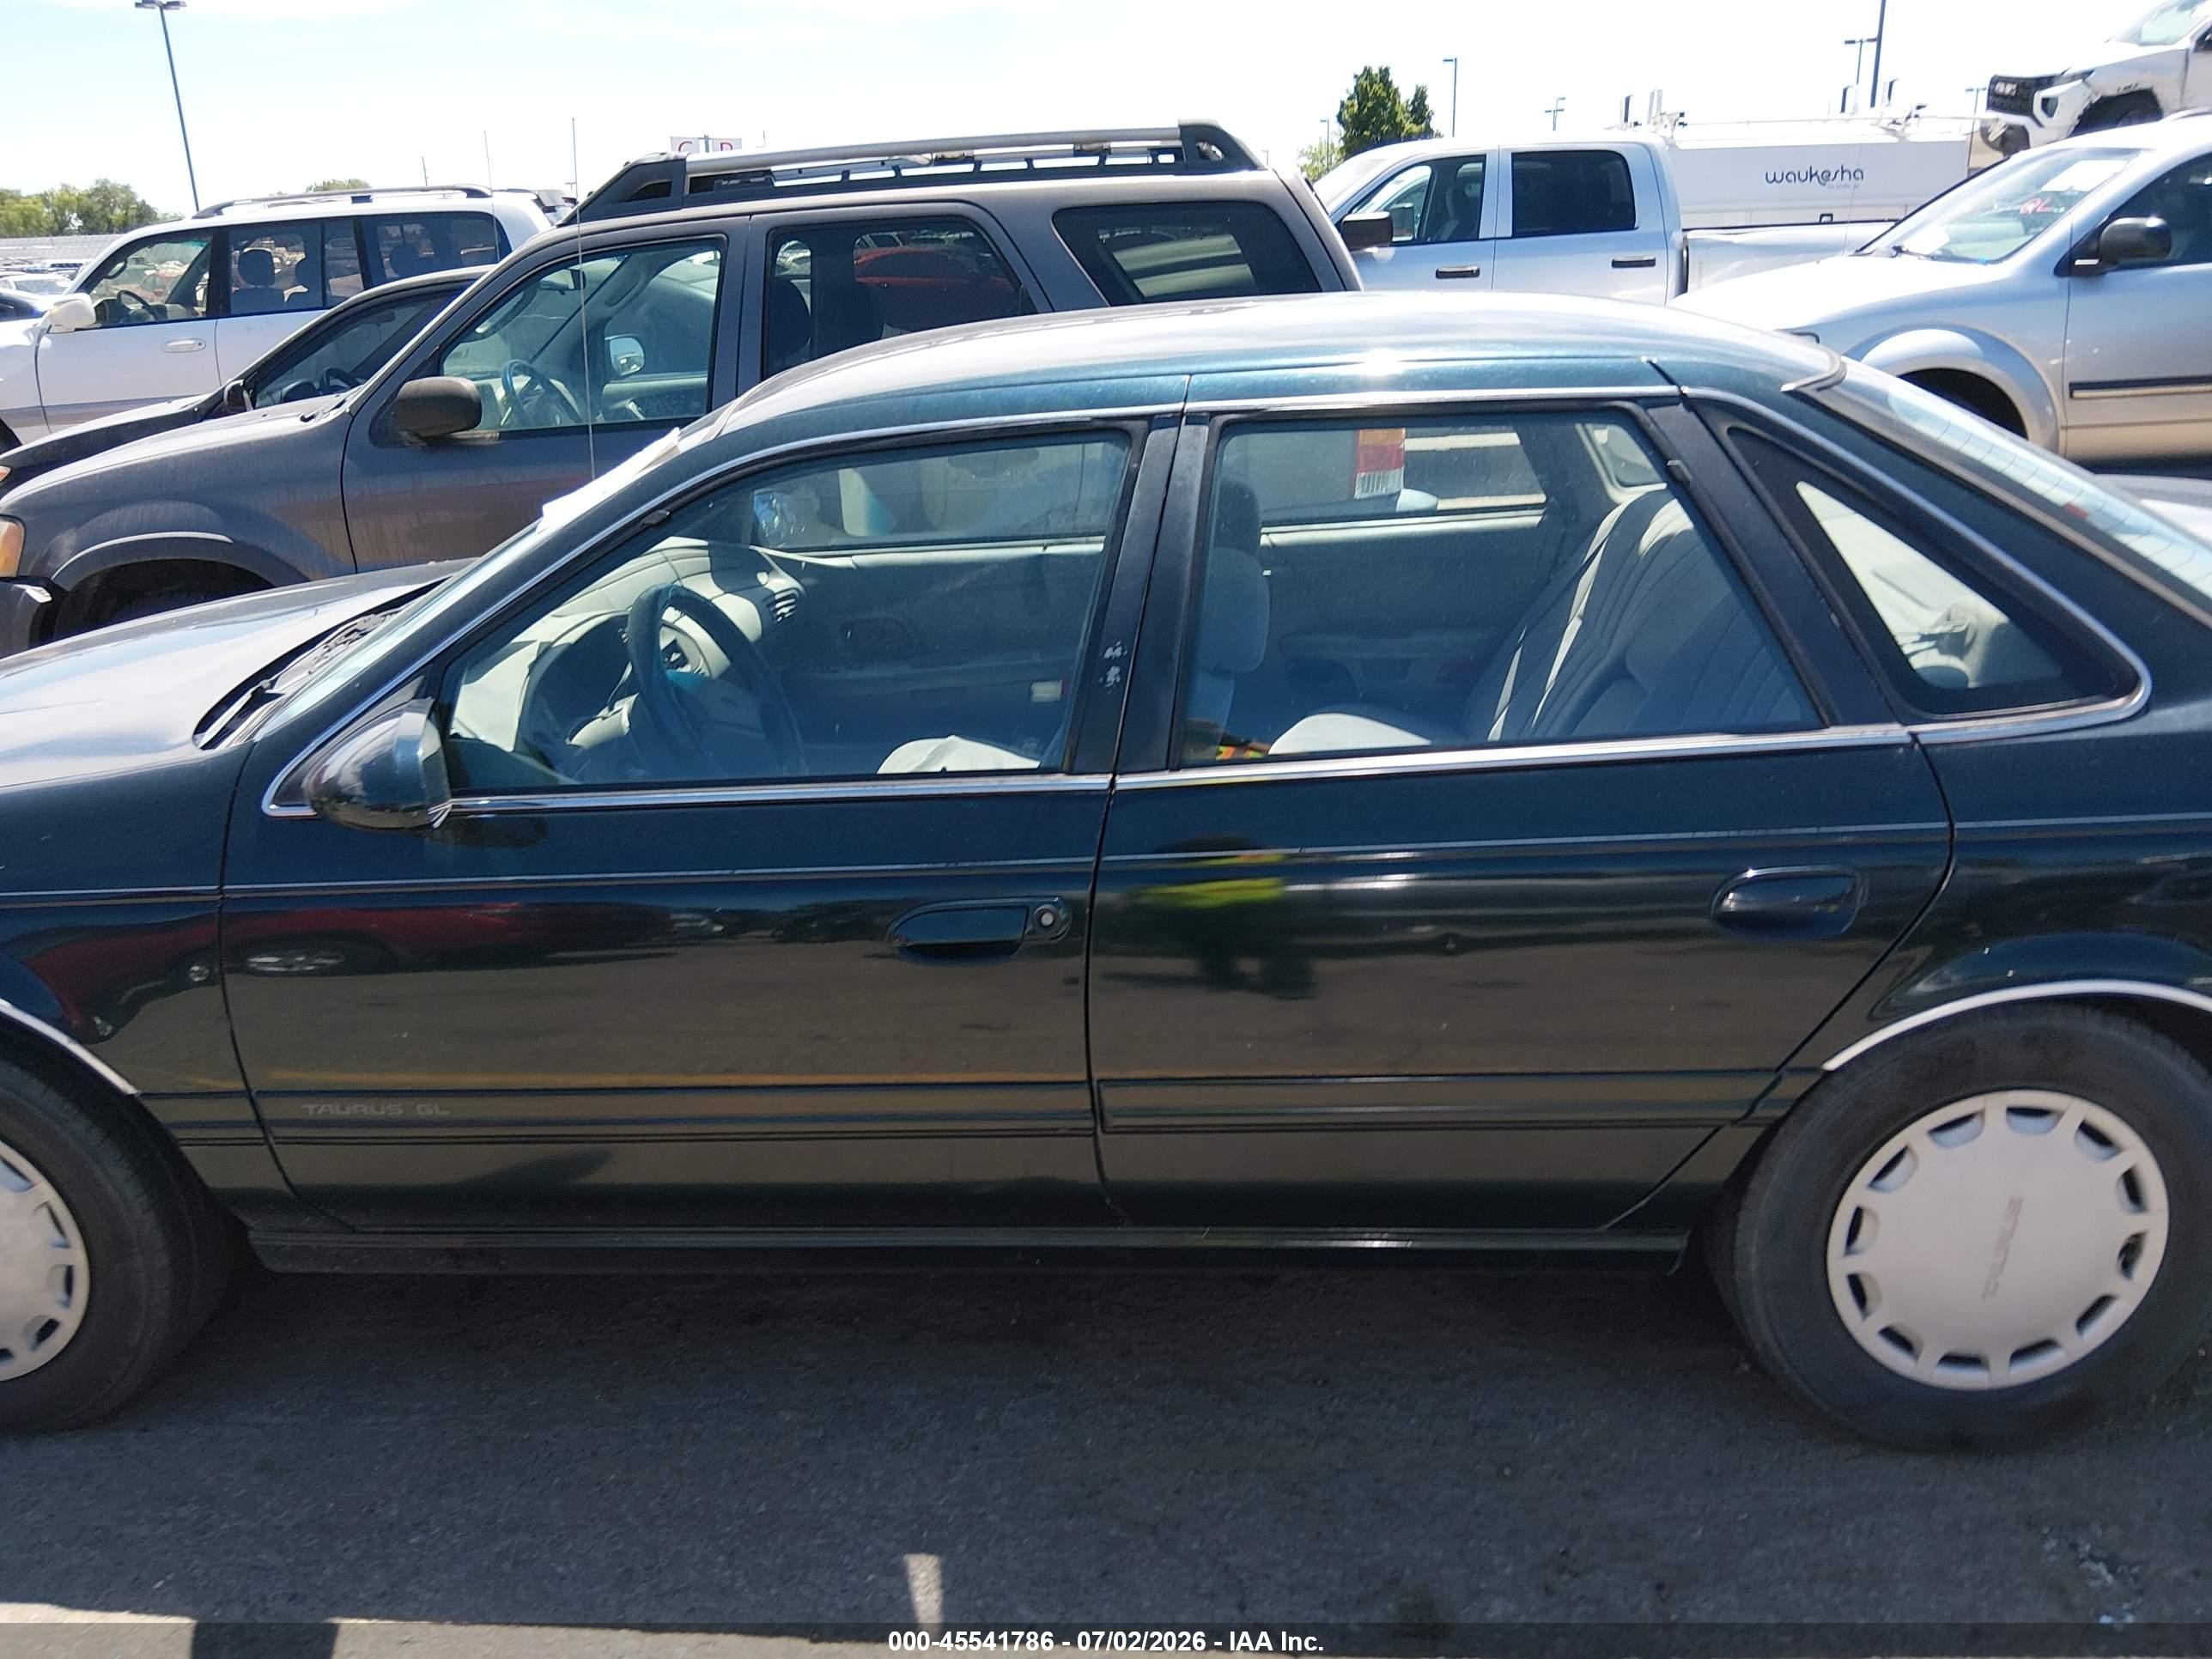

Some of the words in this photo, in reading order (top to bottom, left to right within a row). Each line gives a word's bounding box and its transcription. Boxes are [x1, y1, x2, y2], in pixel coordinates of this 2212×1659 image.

[1765, 164, 1864, 185] waukesha
[301, 1103, 404, 1115] TAURUS
[416, 1103, 451, 1115] GL
